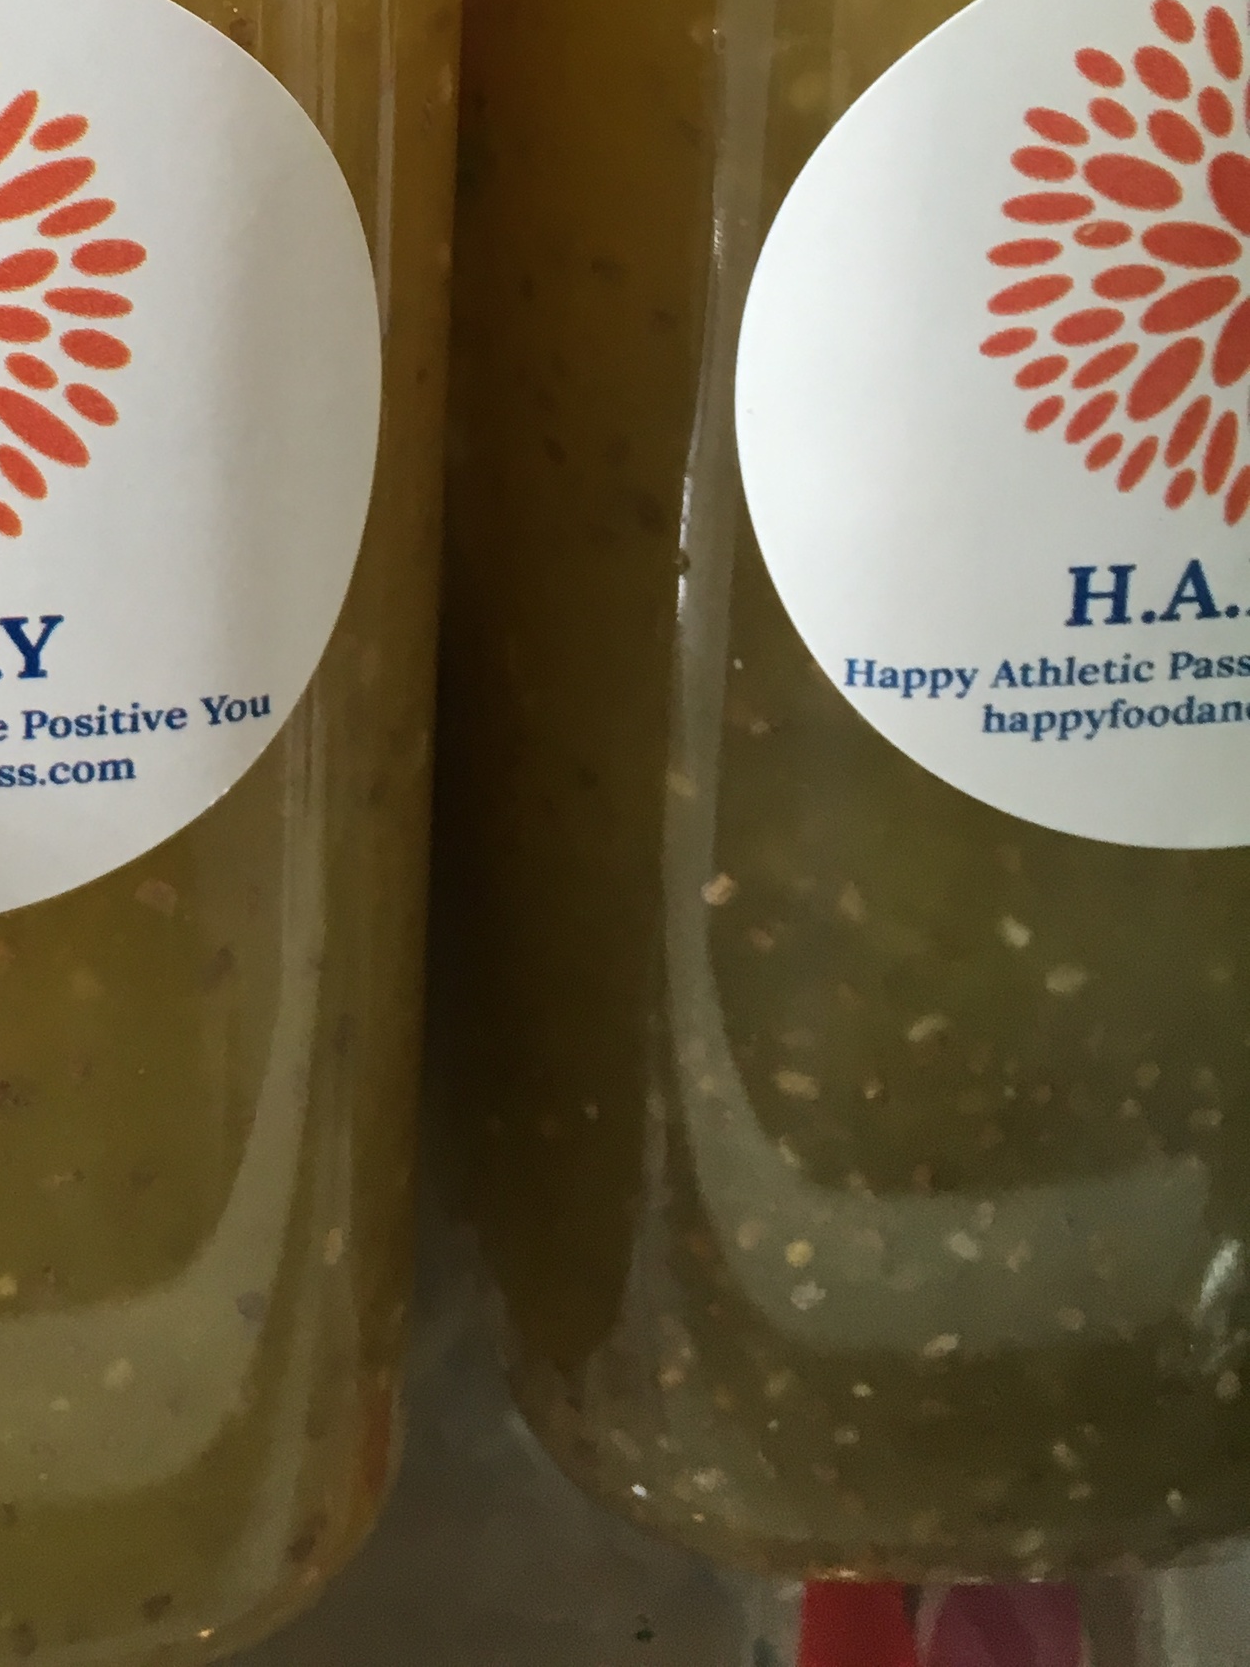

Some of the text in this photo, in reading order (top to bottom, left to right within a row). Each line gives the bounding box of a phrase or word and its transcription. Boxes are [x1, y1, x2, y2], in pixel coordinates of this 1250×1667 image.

[1064, 557, 1250, 628] H.A.
[844, 657, 979, 699] Happy
[989, 653, 1154, 688] Athletic
[21, 704, 188, 741] Positive
[199, 689, 272, 726] You
[981, 695, 1250, 741] happyfoodan
